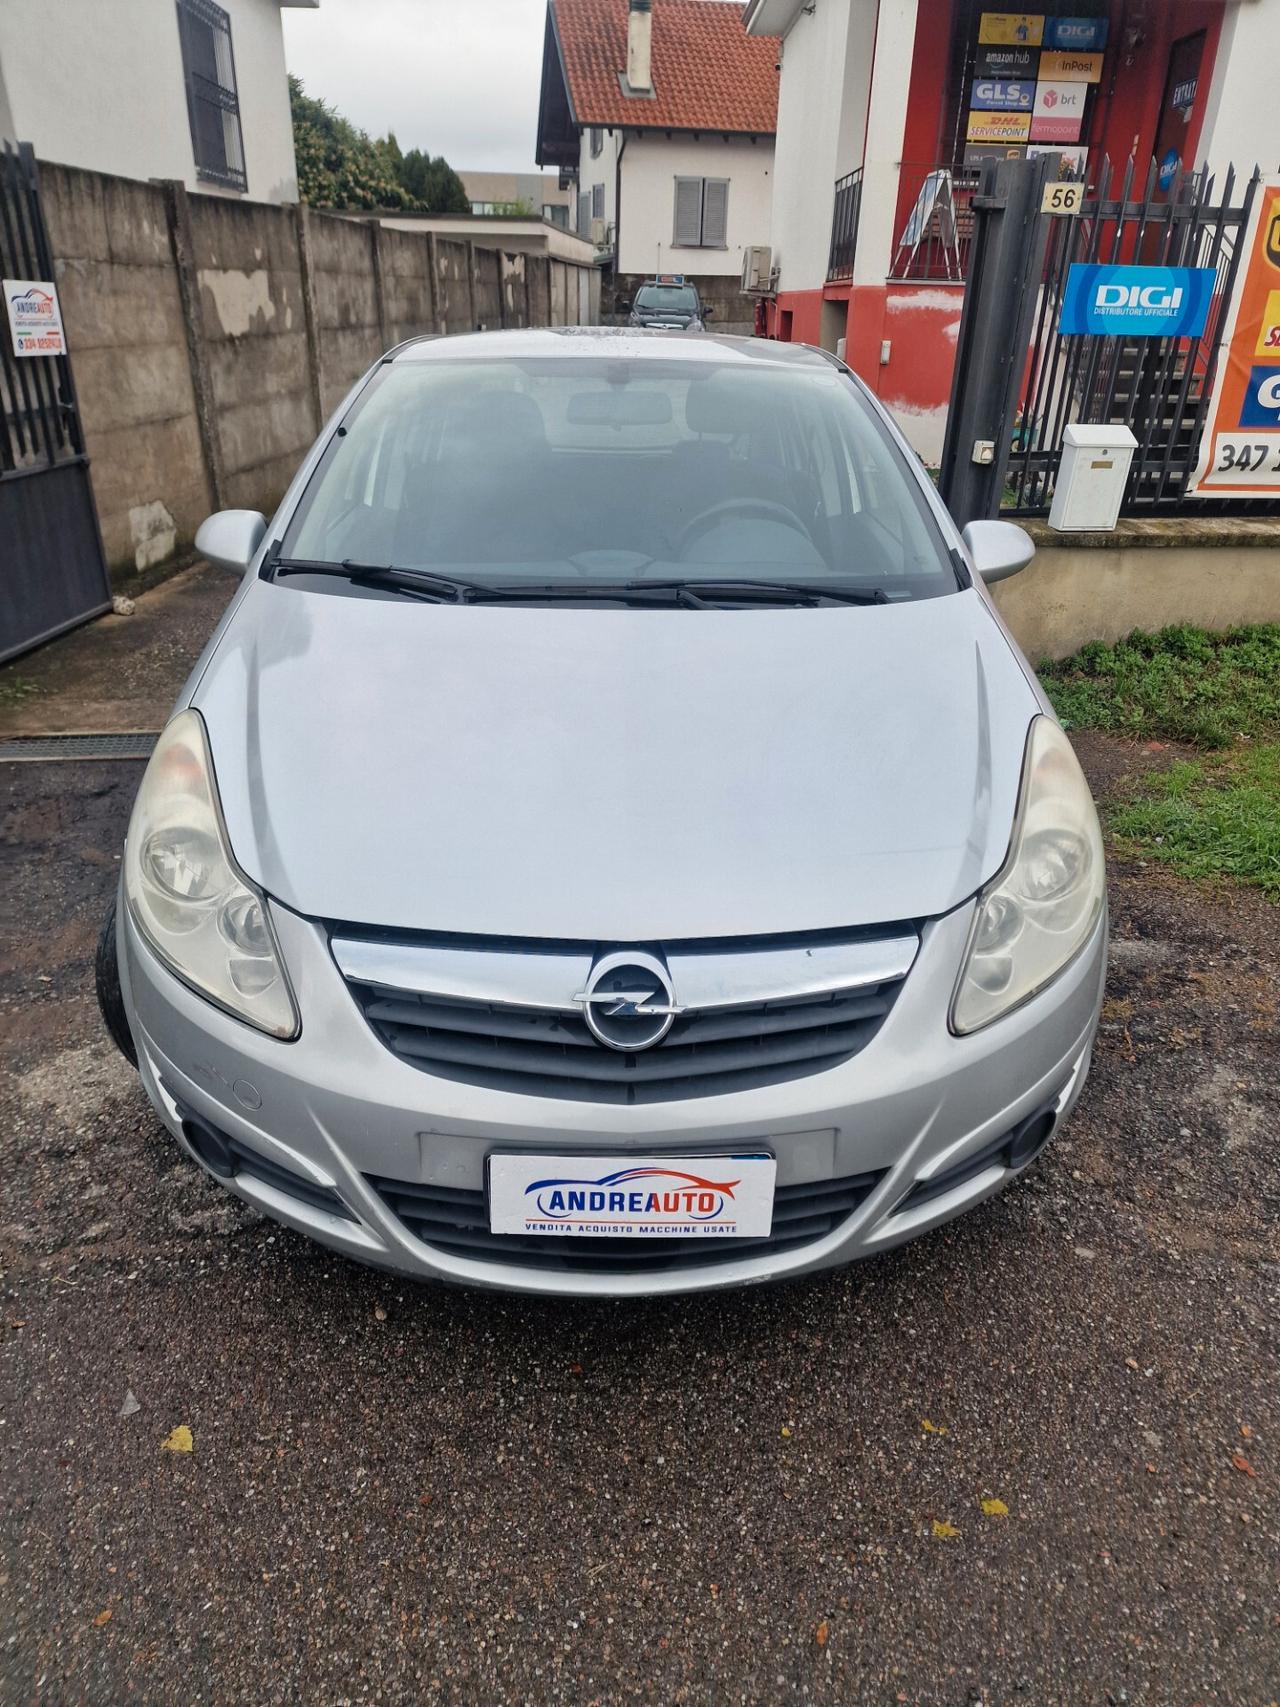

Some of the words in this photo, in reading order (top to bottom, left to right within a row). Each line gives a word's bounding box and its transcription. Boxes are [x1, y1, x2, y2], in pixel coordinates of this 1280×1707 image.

[1057, 25, 1096, 37] DIGI
[985, 51, 1014, 63] amazon
[1014, 50, 1030, 64] hub
[976, 83, 1021, 100] GLS
[1060, 94, 1077, 105] brt
[989, 116, 1021, 126] DHL
[970, 126, 1026, 137] SERVICEPOINT
[1160, 160, 1179, 176] DIGI
[1050, 188, 1076, 208] 56
[1095, 285, 1183, 309] DIGI
[1093, 307, 1143, 316] DISTRIBUTORE
[1144, 308, 1179, 317] UFFICIALE
[1217, 444, 1269, 472] 347
[548, 1190, 716, 1213] ANDREAUTO
[525, 1223, 572, 1232] VENDITA
[578, 1225, 633, 1233] ACQUISTO
[639, 1226, 698, 1234] MACCHINE
[703, 1226, 738, 1234] USATE
